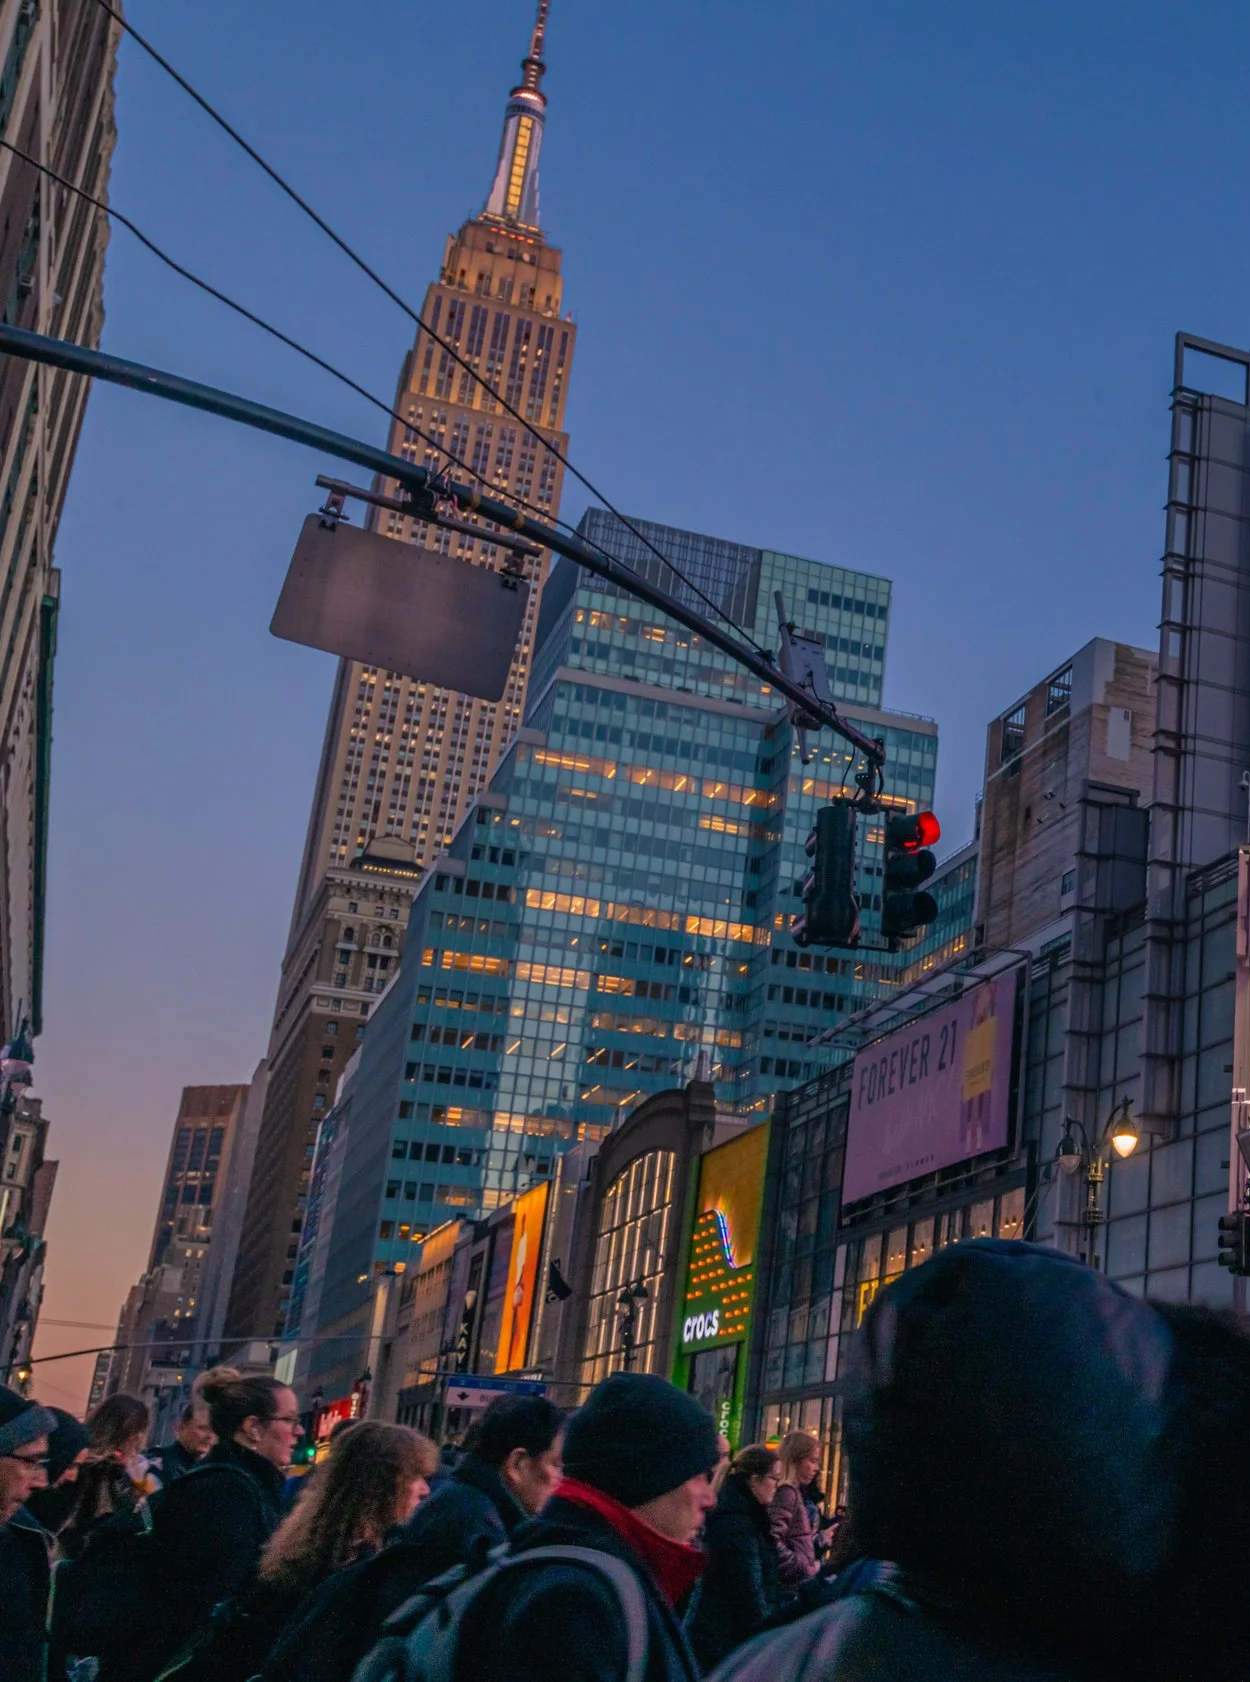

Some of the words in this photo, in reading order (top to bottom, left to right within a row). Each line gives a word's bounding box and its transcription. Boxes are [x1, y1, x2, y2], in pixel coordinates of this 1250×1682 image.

[857, 1034, 931, 1111] FOREVER
[938, 1019, 958, 1072] 21
[457, 1322, 469, 1364] KAY
[683, 1309, 719, 1343] crocs
